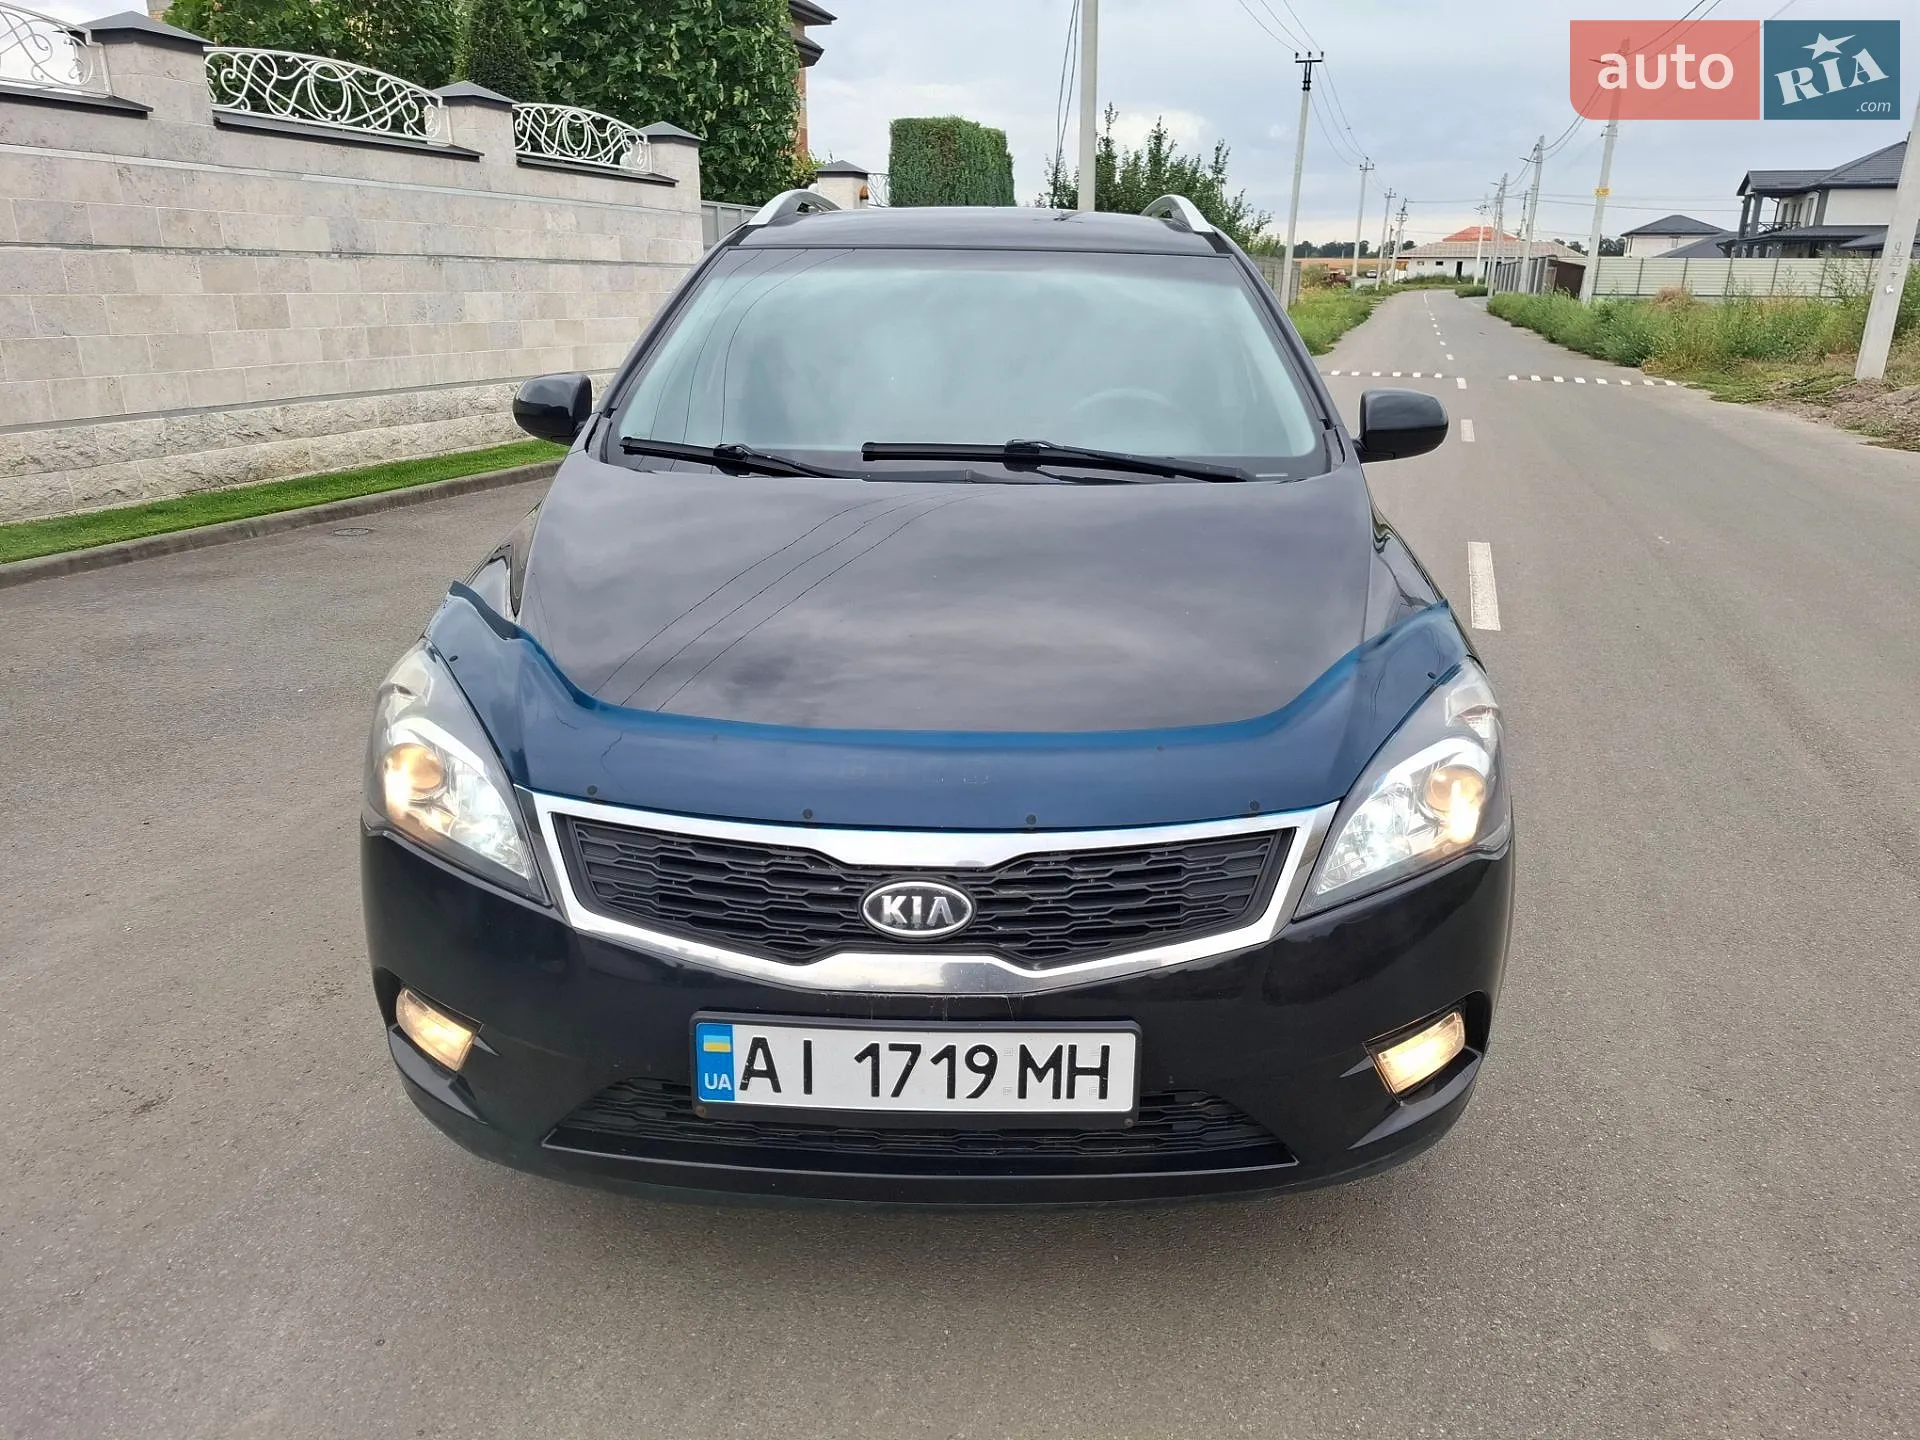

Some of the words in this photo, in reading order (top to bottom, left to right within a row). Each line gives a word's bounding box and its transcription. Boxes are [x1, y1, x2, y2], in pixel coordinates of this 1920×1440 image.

[881, 895, 955, 927] KIA
[704, 1072, 733, 1091] UA
[739, 1036, 813, 1095] AI
[854, 1042, 999, 1099] 1719
[1017, 1044, 1111, 1100] MH
